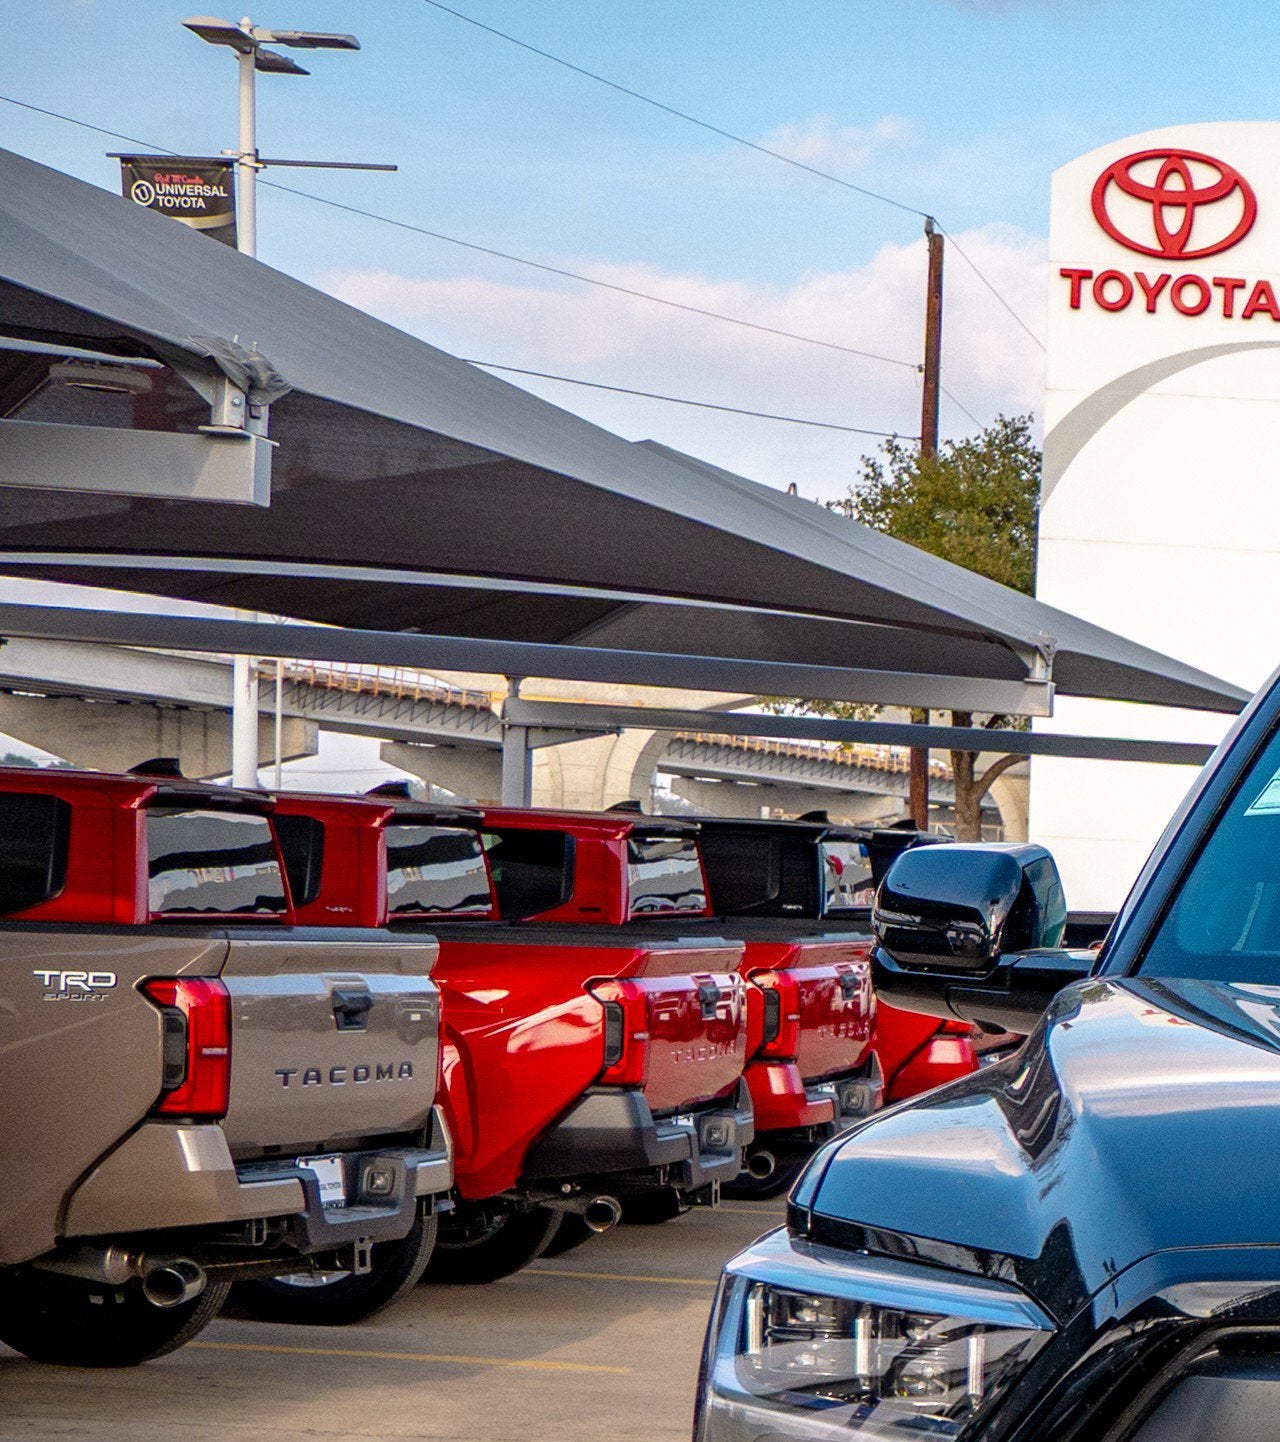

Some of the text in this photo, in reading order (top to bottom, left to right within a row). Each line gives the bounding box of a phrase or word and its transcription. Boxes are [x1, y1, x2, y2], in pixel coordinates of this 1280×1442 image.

[155, 183, 228, 197] UNIVERSAL
[156, 195, 206, 209] TOYOTA
[33, 969, 118, 991] TRD
[43, 993, 109, 1002] SPORT
[274, 1061, 414, 1089] TACOMA
